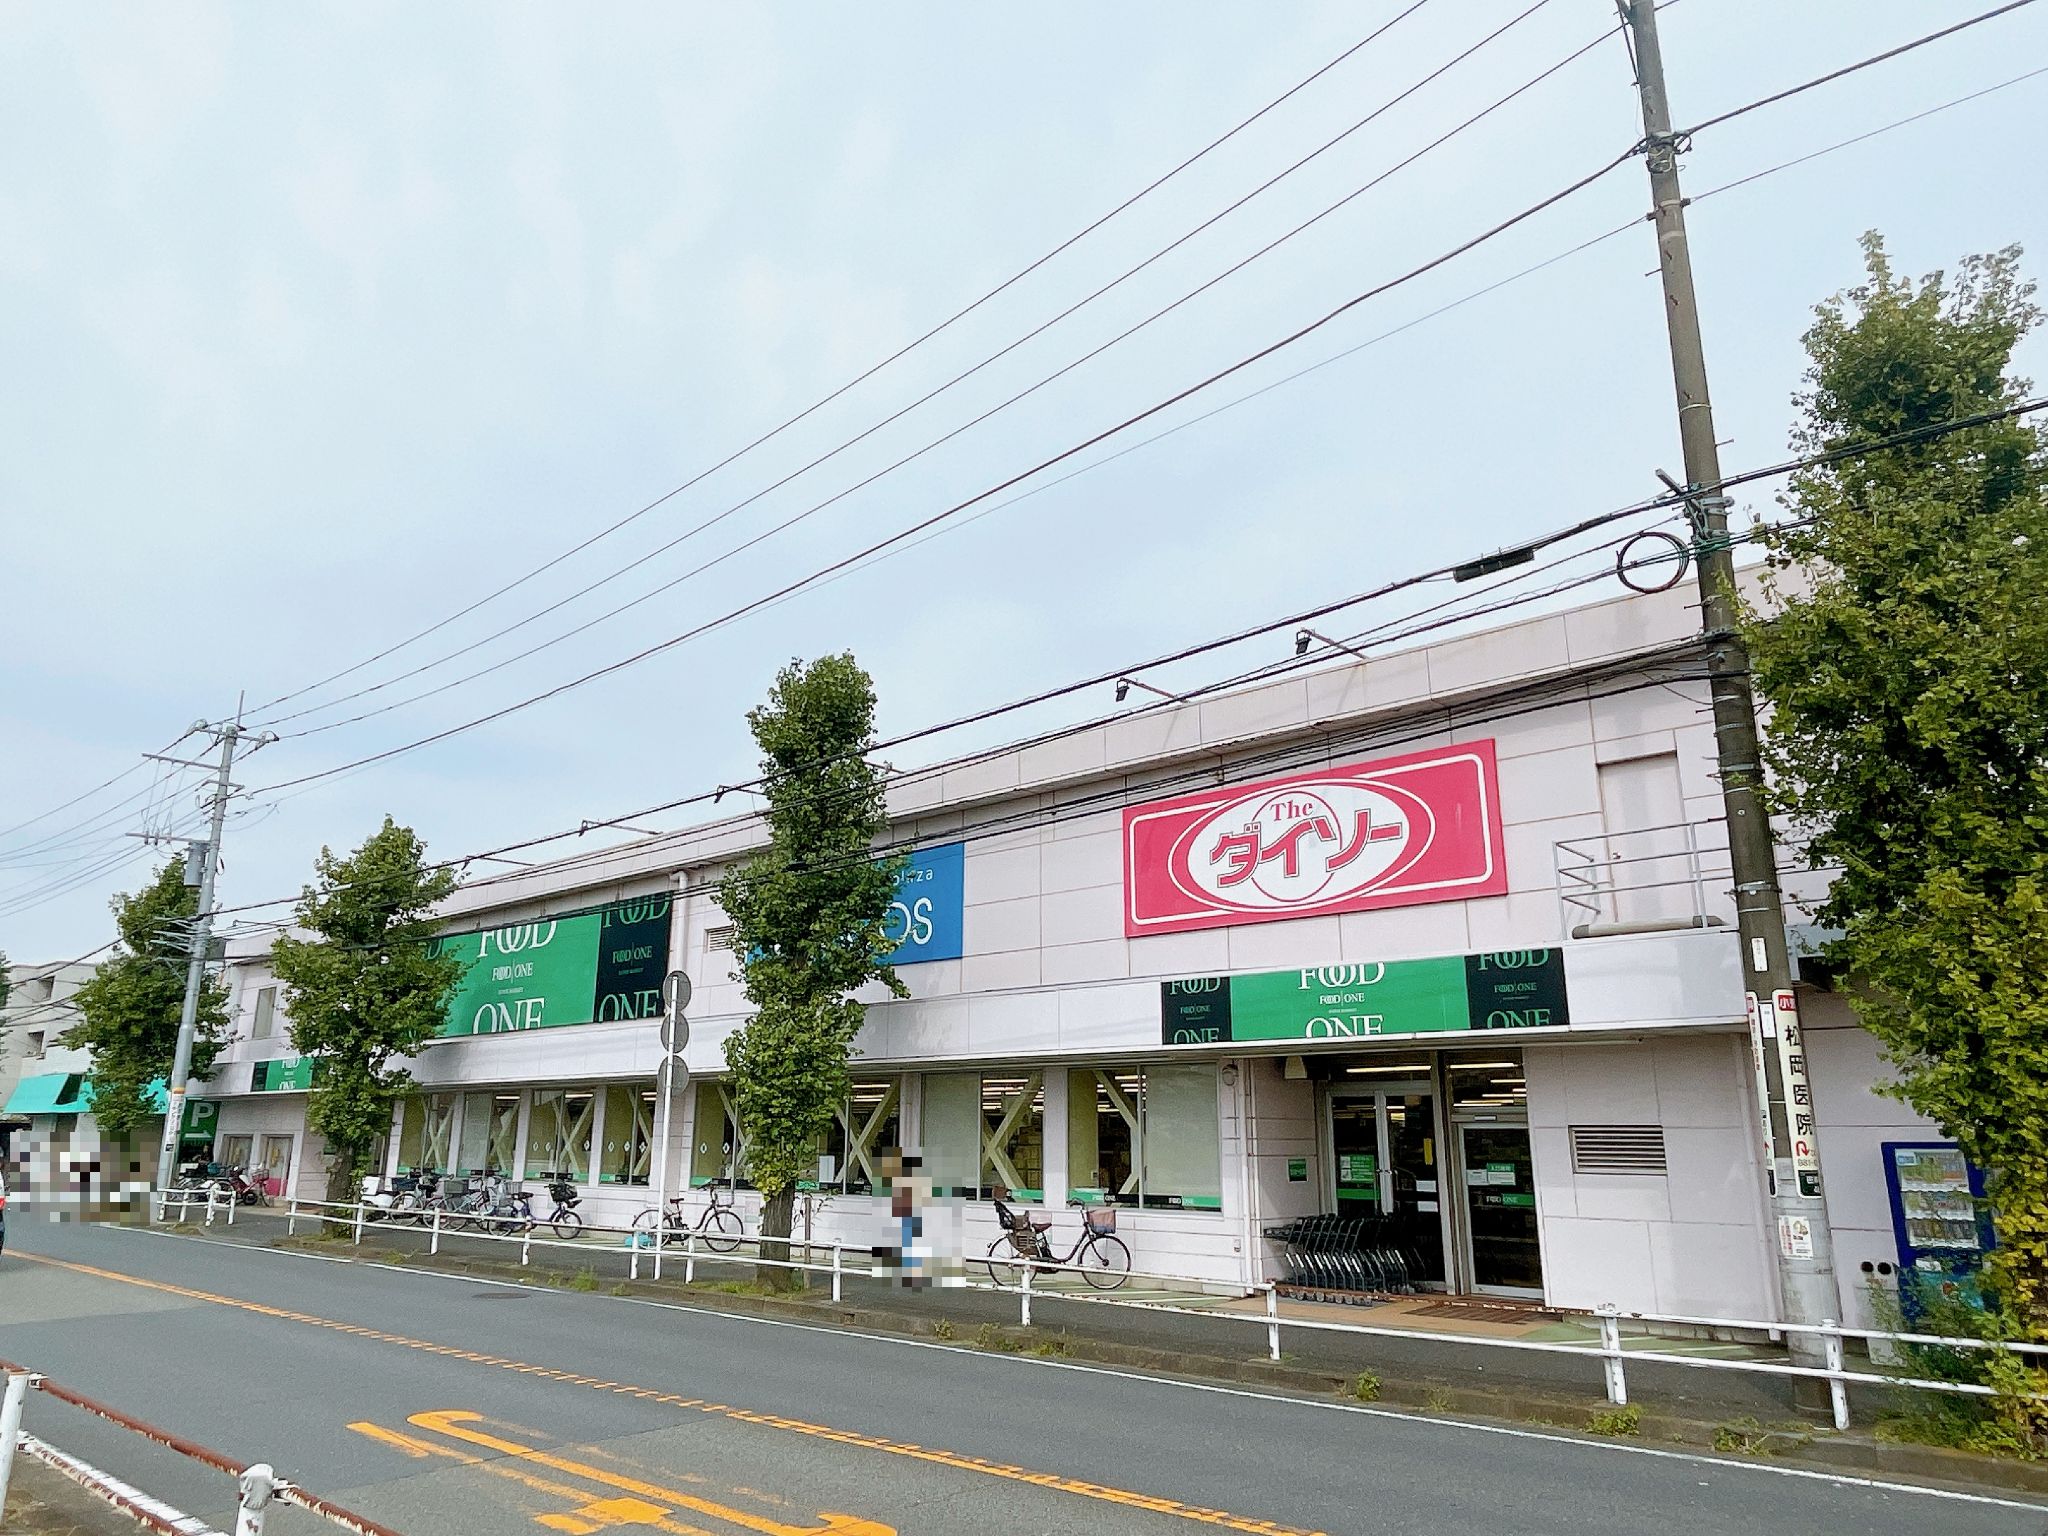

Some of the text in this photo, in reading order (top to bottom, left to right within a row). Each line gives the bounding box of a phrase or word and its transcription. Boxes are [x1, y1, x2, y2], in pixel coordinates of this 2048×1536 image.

[1270, 800, 1314, 821] The
[1209, 808, 1403, 888] ダイソー
[476, 920, 558, 959] FOOD
[612, 945, 653, 963] FOOD ONE
[1477, 948, 1549, 972] FOOD
[491, 962, 534, 982] FOOD ONE
[1297, 961, 1385, 990] FOOD
[1169, 977, 1221, 996] FOOD
[1516, 982, 1537, 991] ONE
[598, 989, 660, 1022] ONE
[1319, 993, 1365, 1005] FOOD ONE
[472, 997, 545, 1035] ONE
[1305, 1014, 1384, 1039] ONE
[1486, 1009, 1550, 1029] ONE
[1173, 1027, 1219, 1044] ONE
[1784, 1024, 1813, 1136] 松岡医院
[190, 1102, 215, 1128] P
